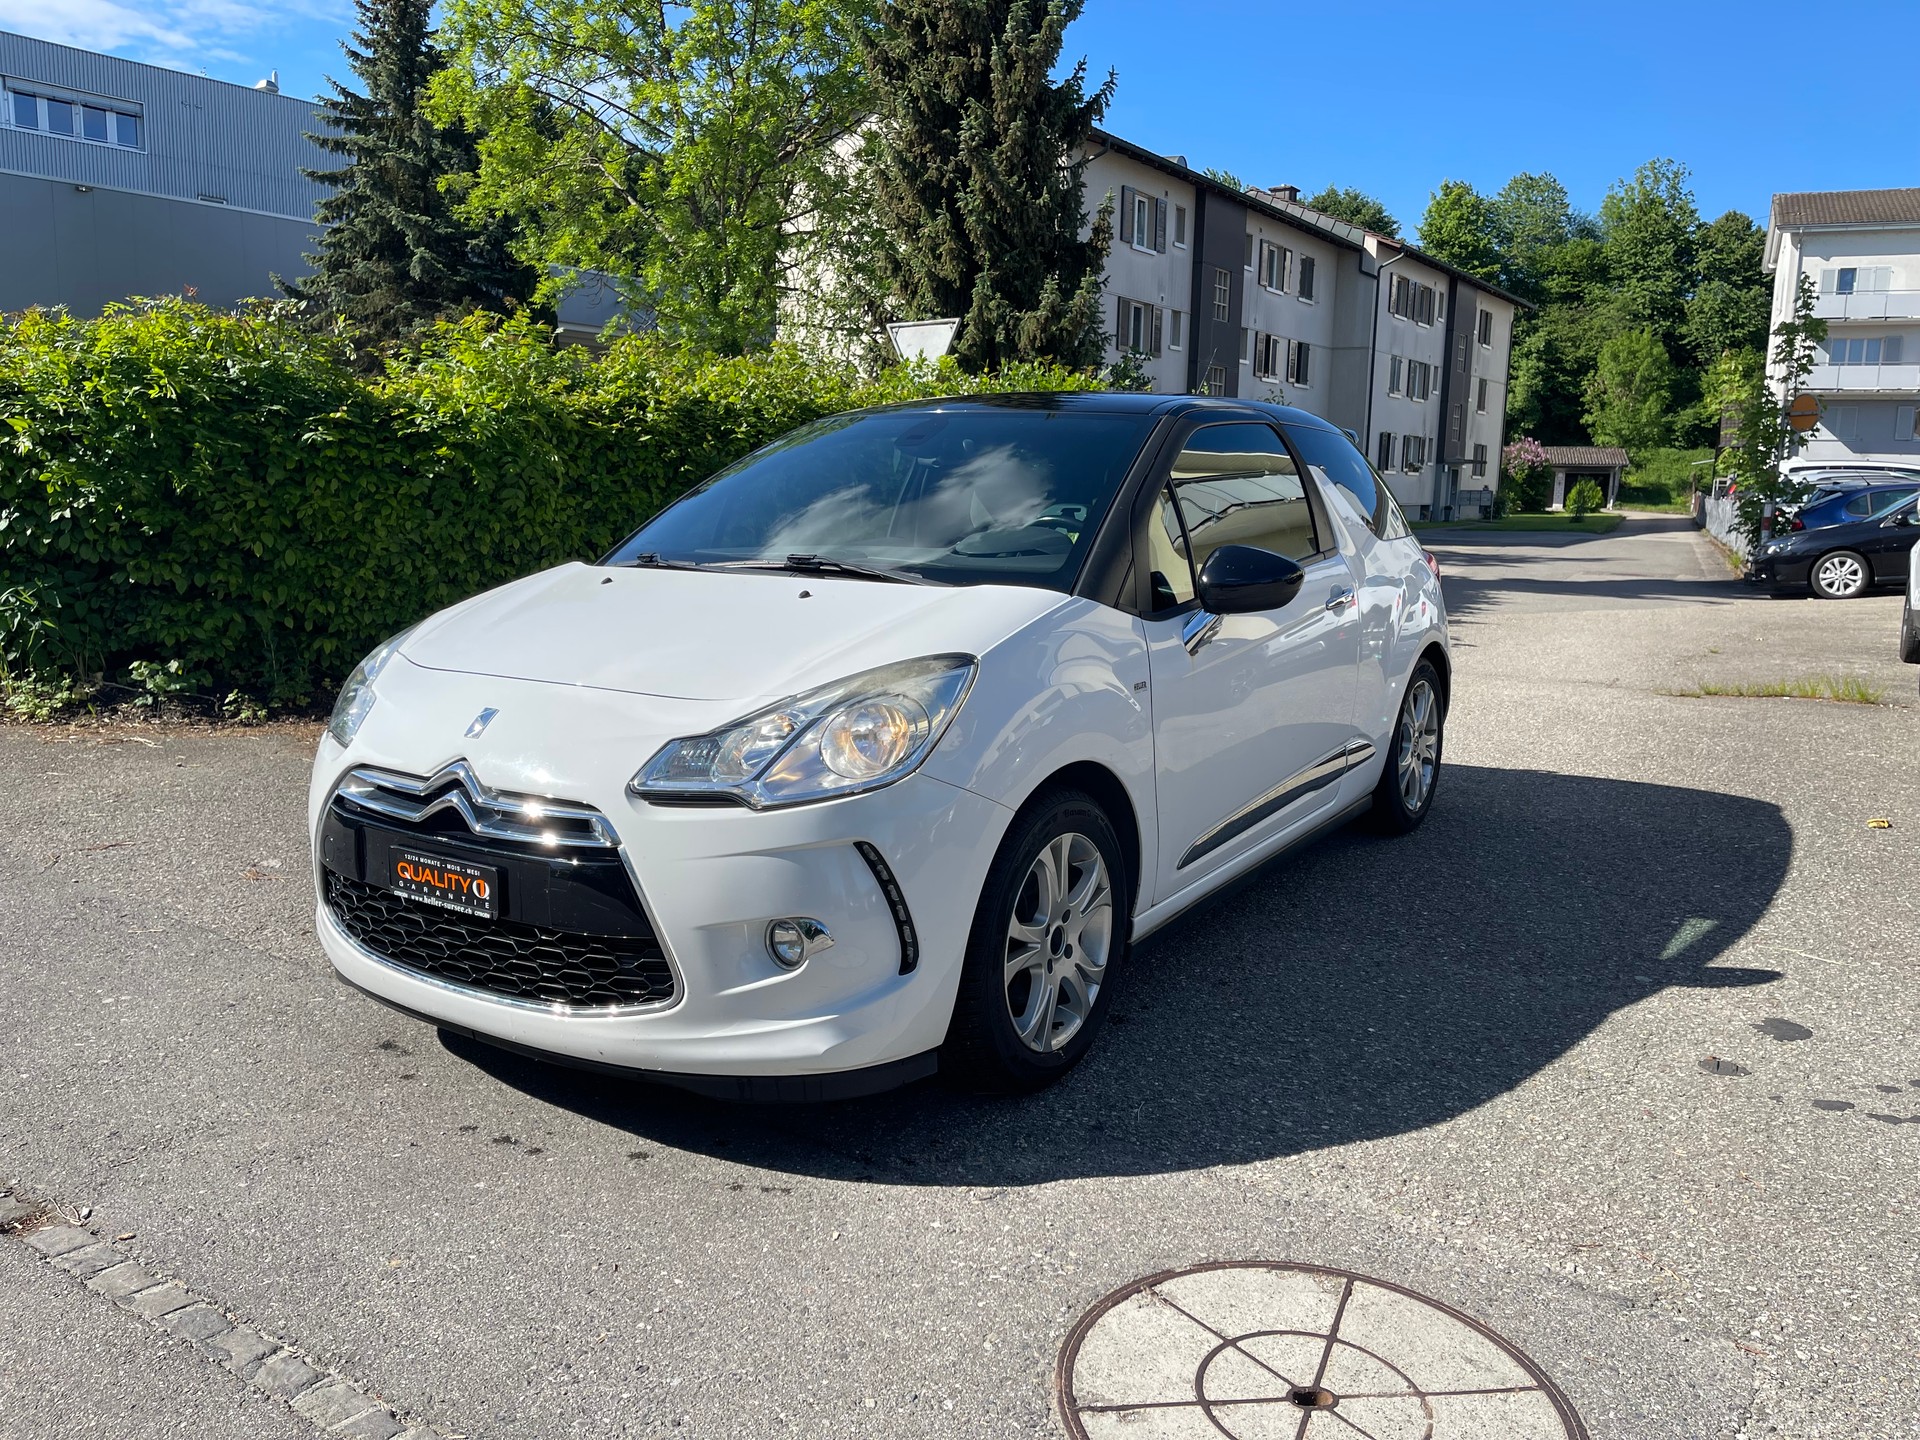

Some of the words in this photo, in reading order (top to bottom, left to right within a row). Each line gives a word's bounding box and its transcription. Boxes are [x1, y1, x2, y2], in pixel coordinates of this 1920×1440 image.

[397, 861, 471, 893] QUALITY
[420, 857, 440, 867] MONATE
[447, 864, 461, 872] MOIS
[467, 868, 480, 876] MESI
[399, 881, 489, 908] GARANTIE
[411, 895, 473, 915] www.heller-sursee.ch
